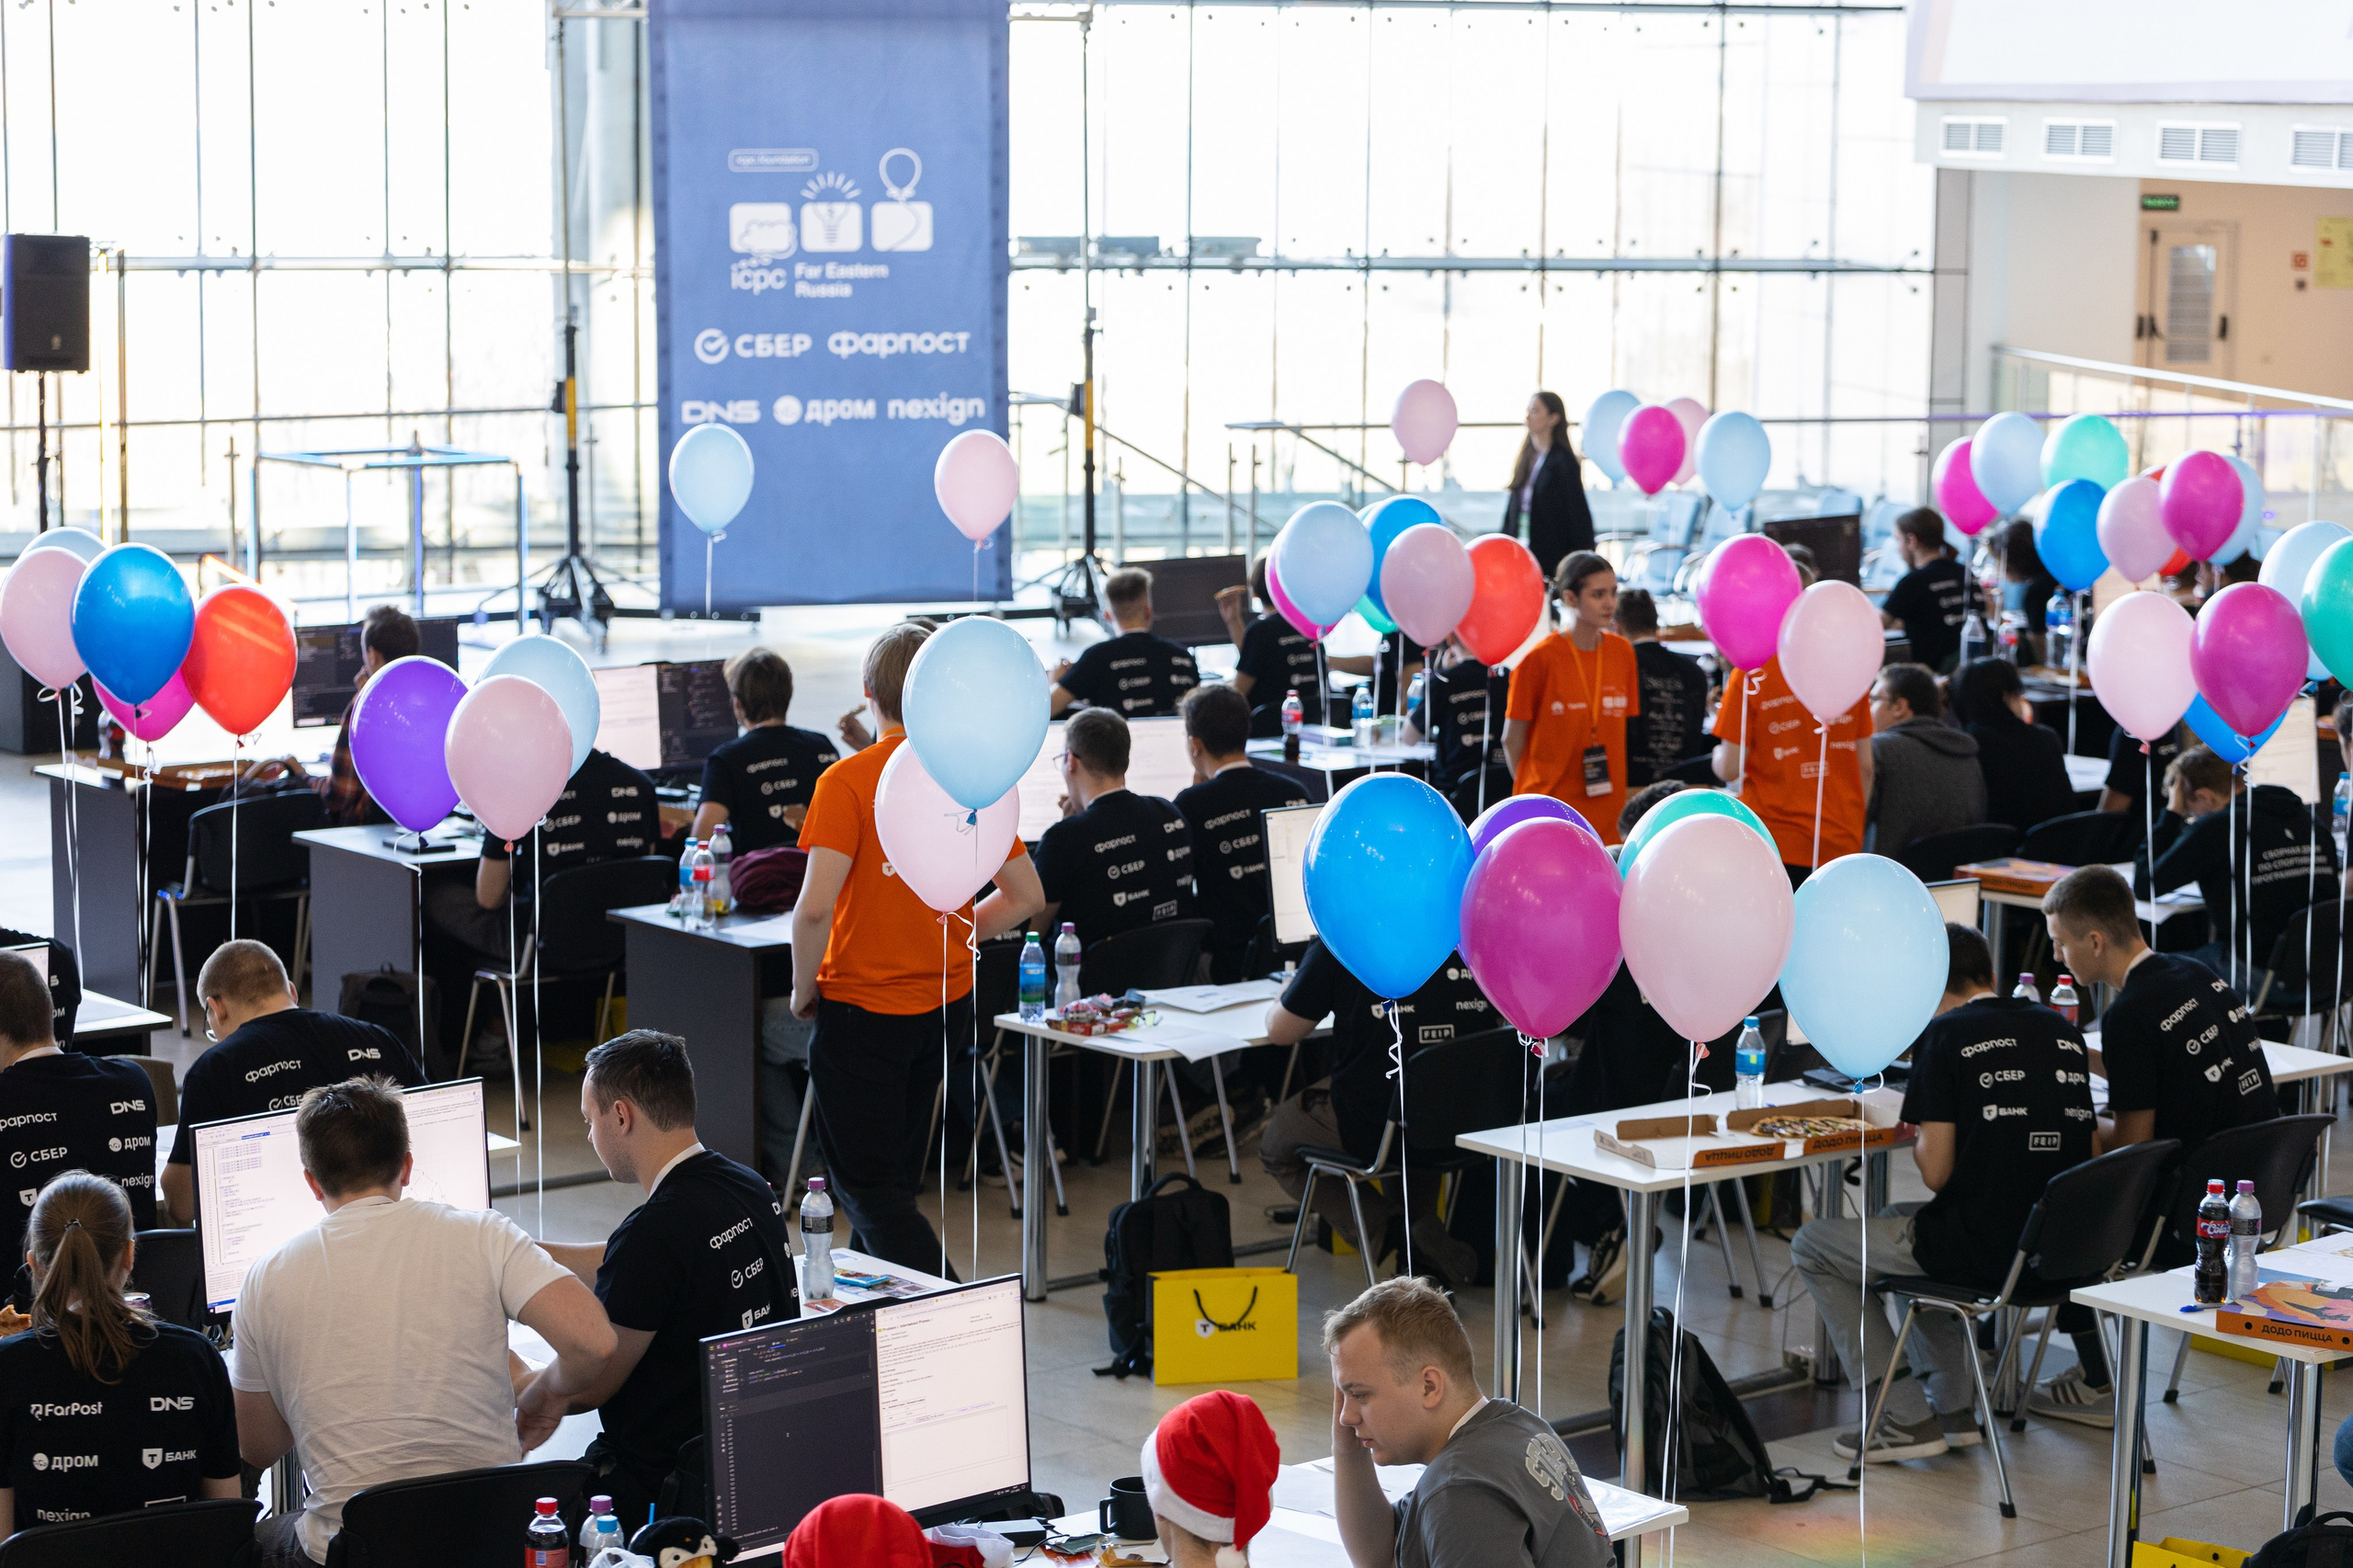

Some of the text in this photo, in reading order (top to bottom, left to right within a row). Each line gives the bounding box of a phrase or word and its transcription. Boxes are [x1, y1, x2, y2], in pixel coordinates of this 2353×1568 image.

[794, 261, 889, 279] Far Eastern
[731, 263, 788, 296] icpc
[794, 280, 853, 298] Russia
[734, 333, 813, 358] СБЕР
[681, 392, 985, 426] DNS дром nexign
[1423, 1029, 1450, 1040] FEIP
[347, 1048, 381, 1062] DNS
[1961, 1039, 2018, 1058] фарпост
[244, 1059, 301, 1084] фарпост
[1995, 1070, 2026, 1082] СБЕР
[110, 1099, 145, 1115] DNS
[283, 1094, 304, 1108] СБЕ
[124, 1135, 151, 1152] дром
[1812, 1136, 1843, 1149] ДОДО
[30, 1146, 68, 1163] СБЕР
[121, 1172, 154, 1188] nexign
[710, 1217, 753, 1250] фарпост
[745, 1257, 764, 1279] СБЕР
[2261, 1324, 2334, 1343] ДОДО ПИЦЦА
[45, 1402, 103, 1416] FarPost
[150, 1396, 195, 1412] DNS
[51, 1455, 99, 1472] дром
[165, 1449, 198, 1462] БАНК
